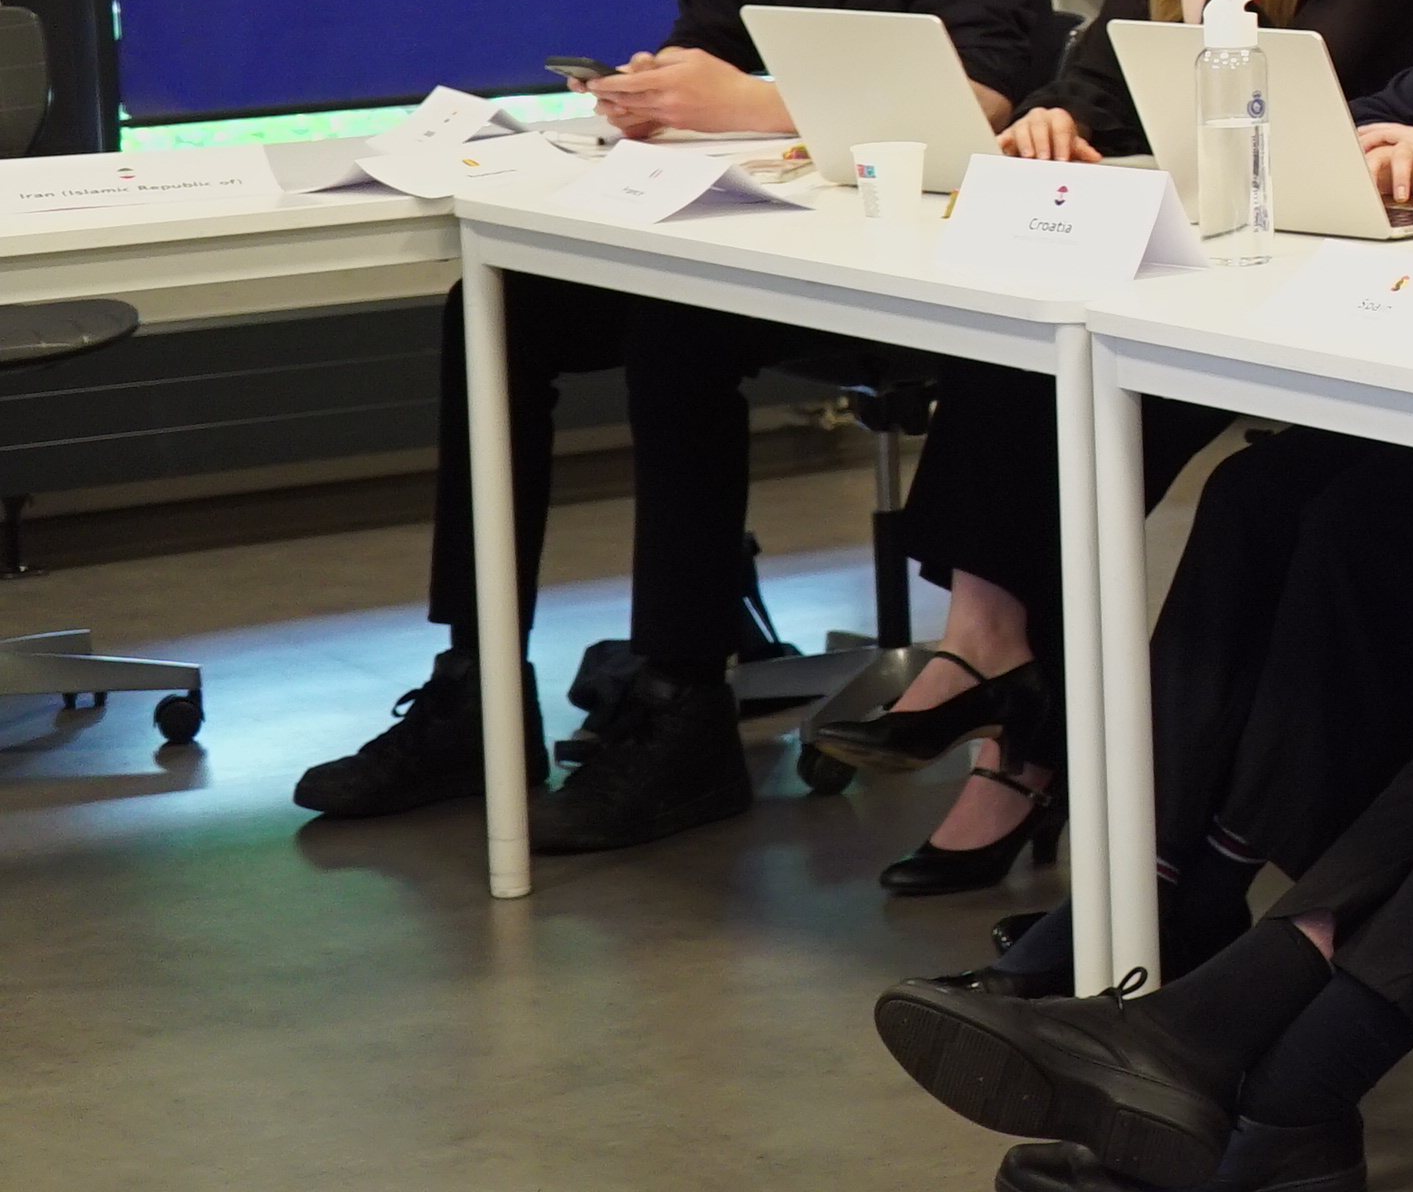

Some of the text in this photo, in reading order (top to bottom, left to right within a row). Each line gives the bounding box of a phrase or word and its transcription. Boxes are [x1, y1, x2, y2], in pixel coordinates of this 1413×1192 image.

[61, 185, 130, 197] (Islamic
[138, 180, 210, 192] Republic
[220, 178, 243, 186] of)
[1028, 216, 1073, 235] Croatia
